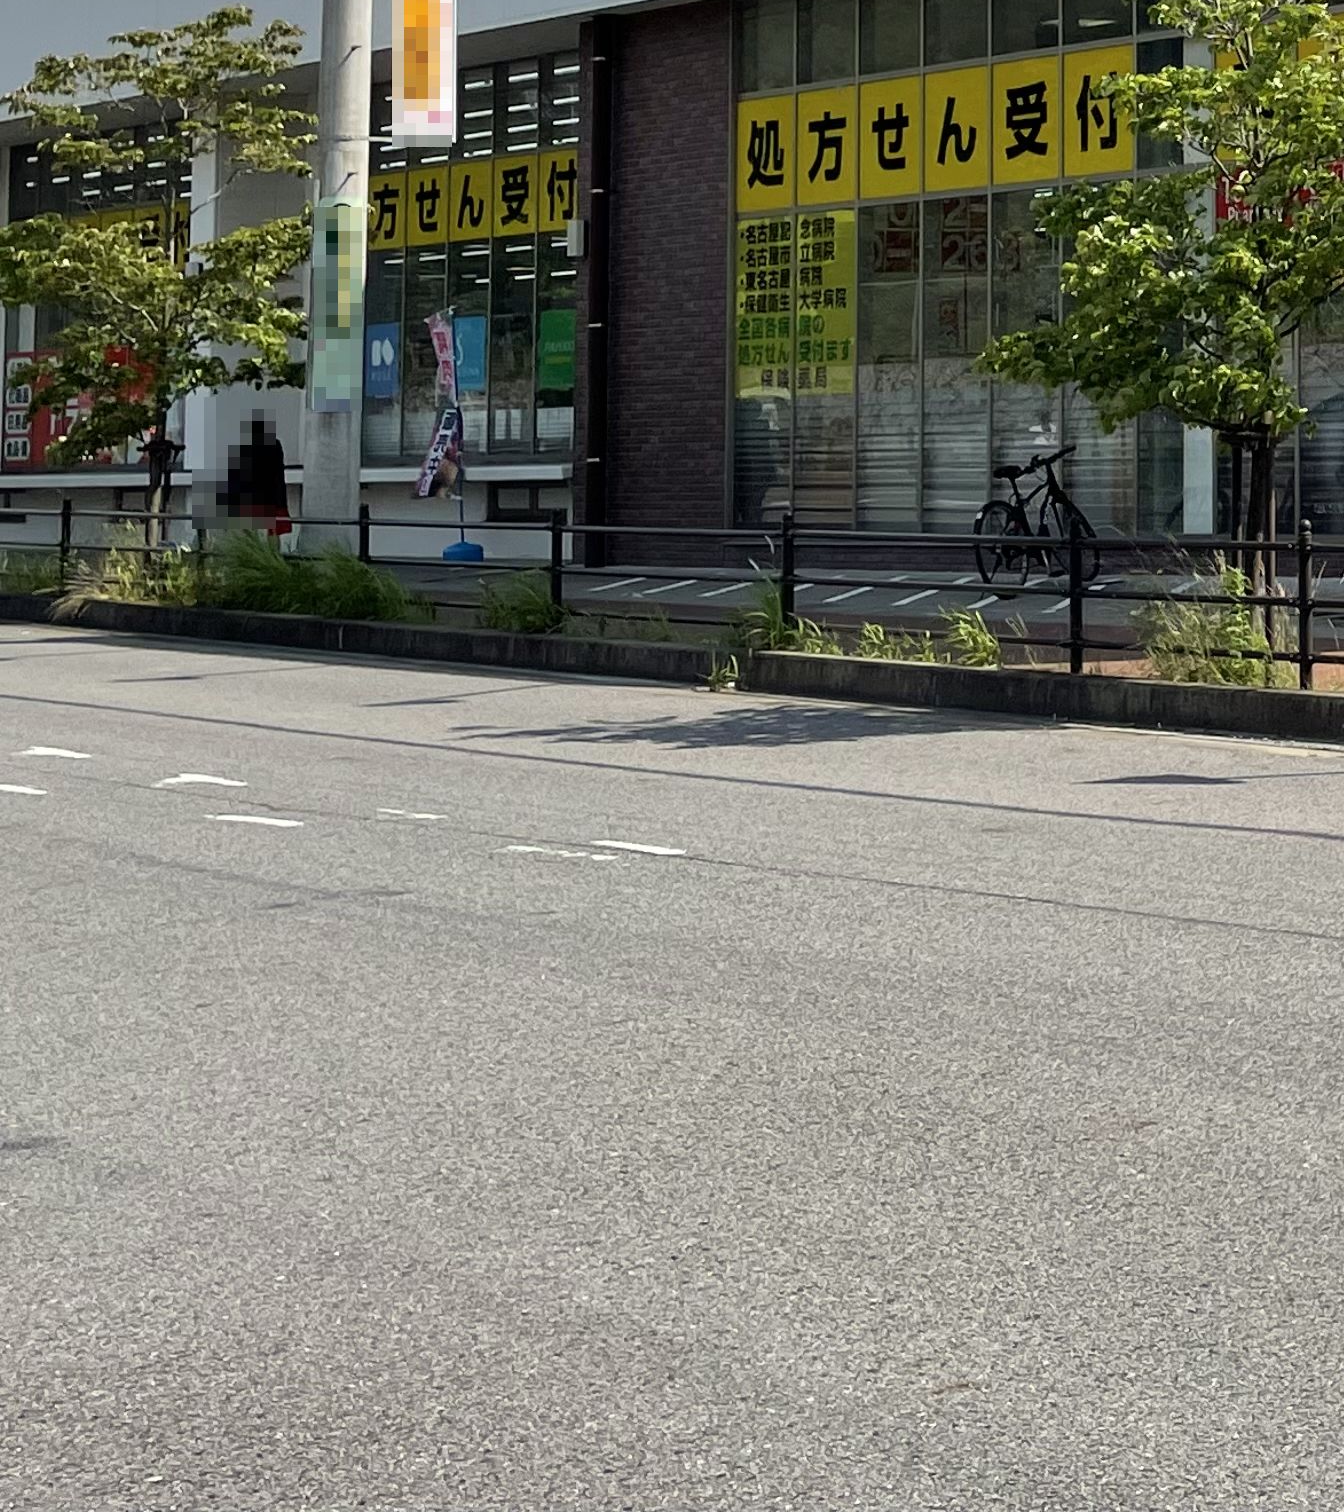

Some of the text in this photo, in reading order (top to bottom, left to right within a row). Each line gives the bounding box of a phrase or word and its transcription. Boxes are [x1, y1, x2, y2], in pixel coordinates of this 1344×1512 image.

[747, 72, 1120, 190] 処方せん受付
[373, 159, 577, 240] 方せん受付
